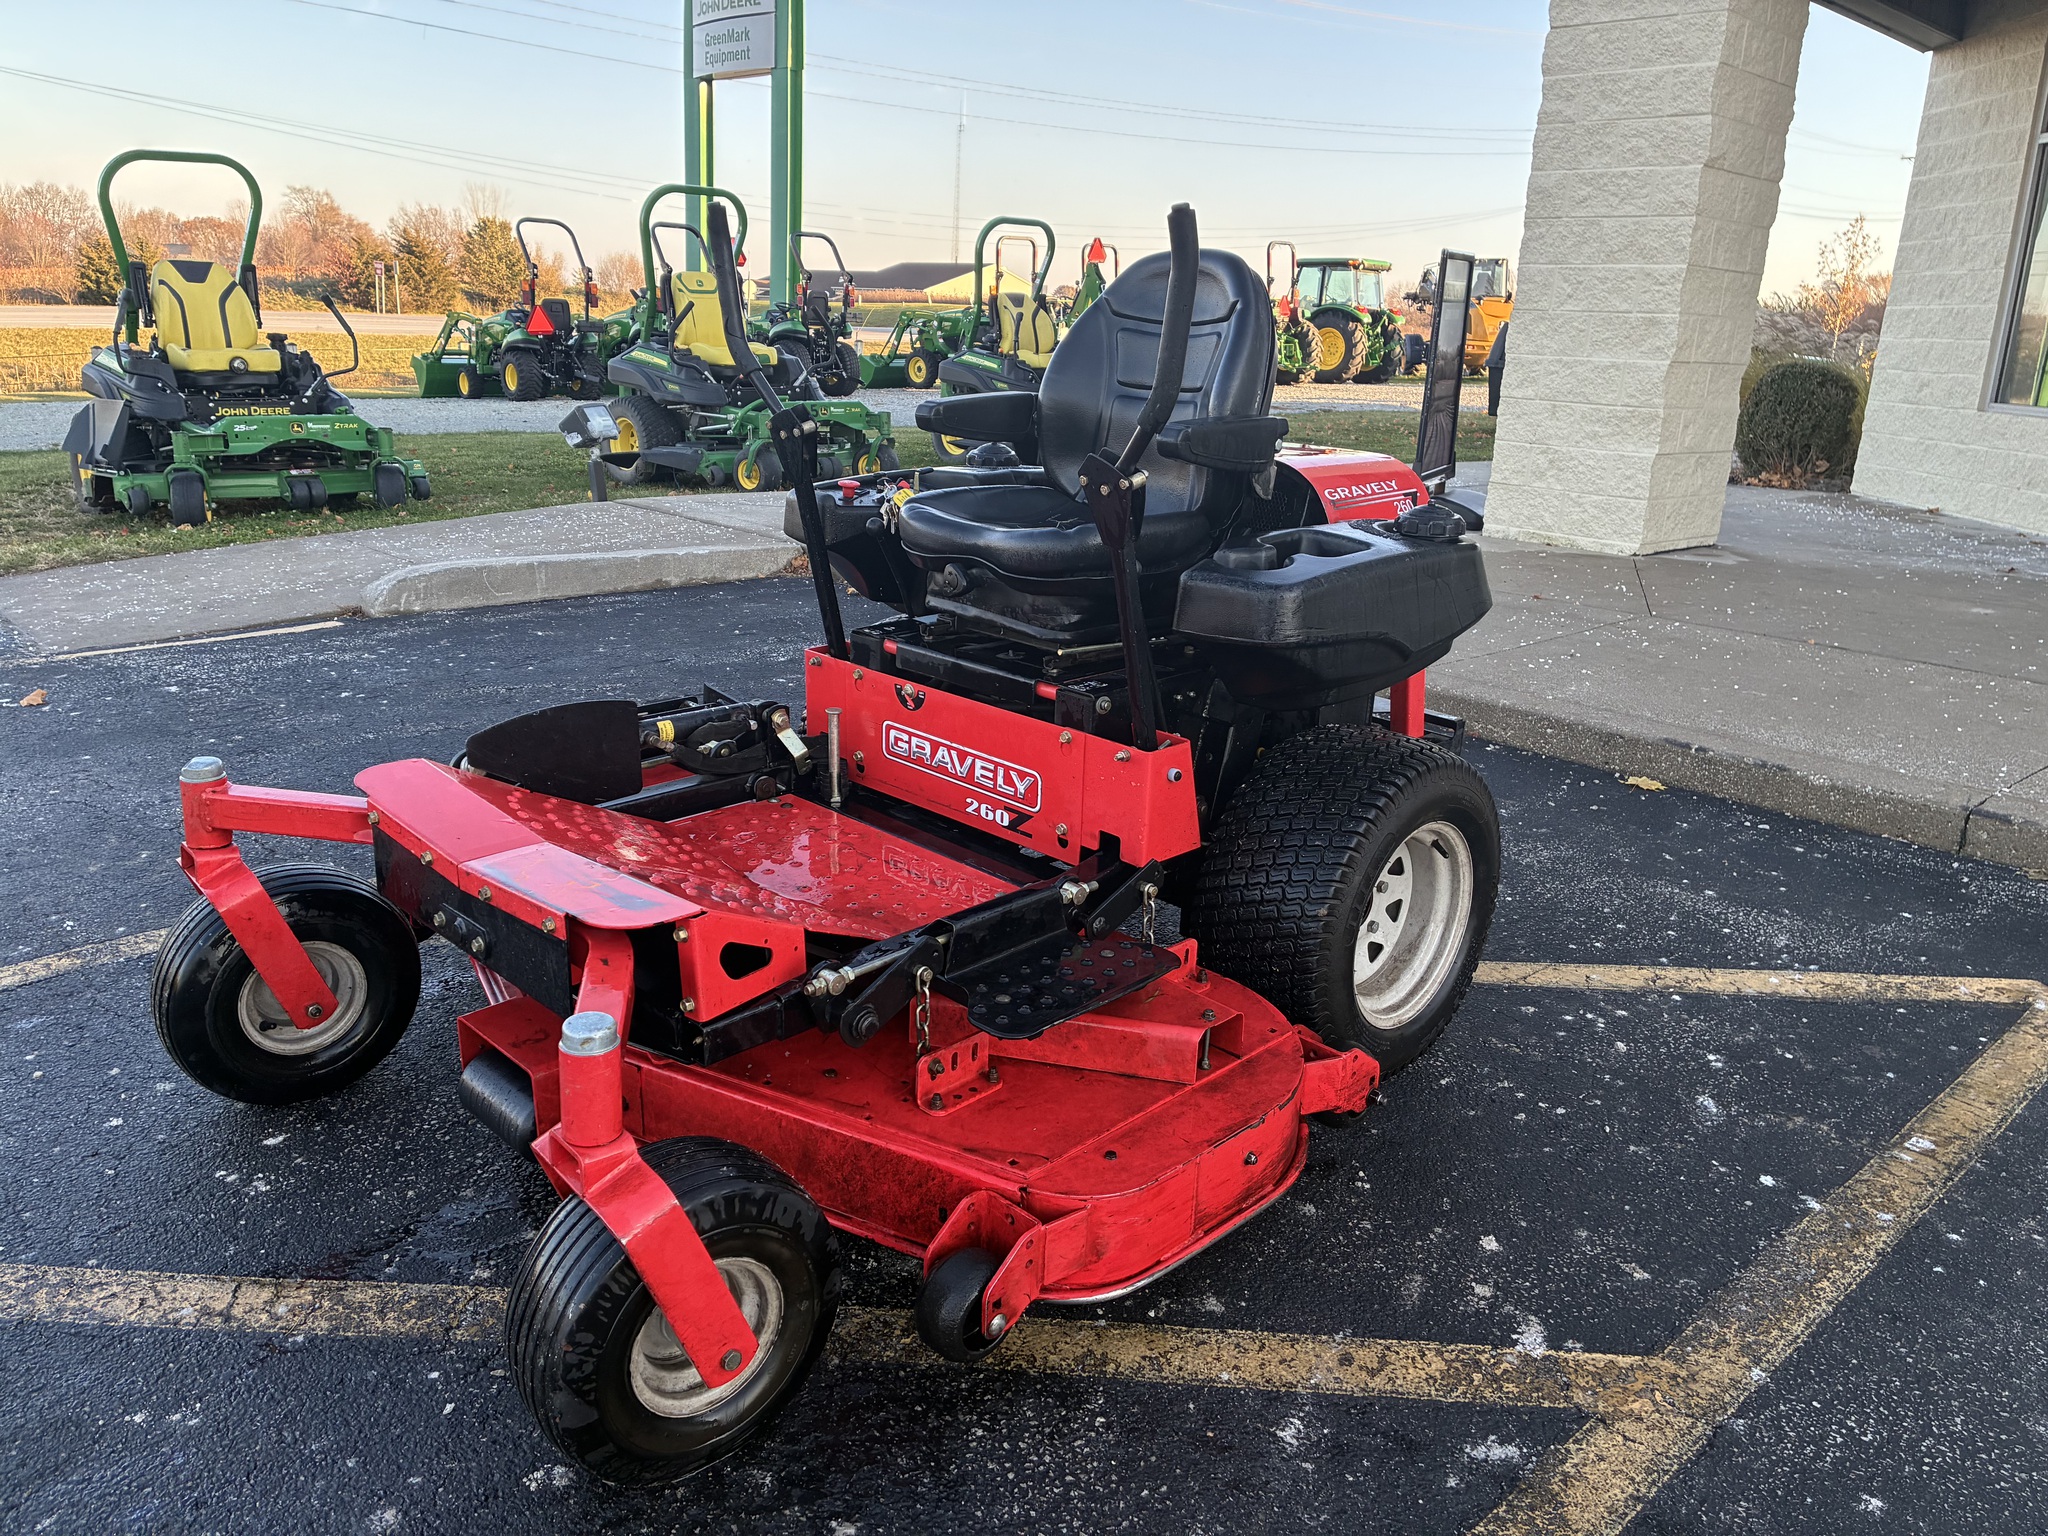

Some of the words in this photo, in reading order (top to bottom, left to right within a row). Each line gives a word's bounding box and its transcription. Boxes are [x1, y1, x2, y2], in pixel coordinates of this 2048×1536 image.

[697, 0, 720, 17] JOHN
[704, 26, 751, 48] GreenMark
[704, 45, 751, 68] Equipment
[215, 406, 249, 416] JOHN
[250, 406, 291, 416] DEERE
[1323, 479, 1399, 501] GRAVELY
[889, 728, 1035, 799] GRAVELY
